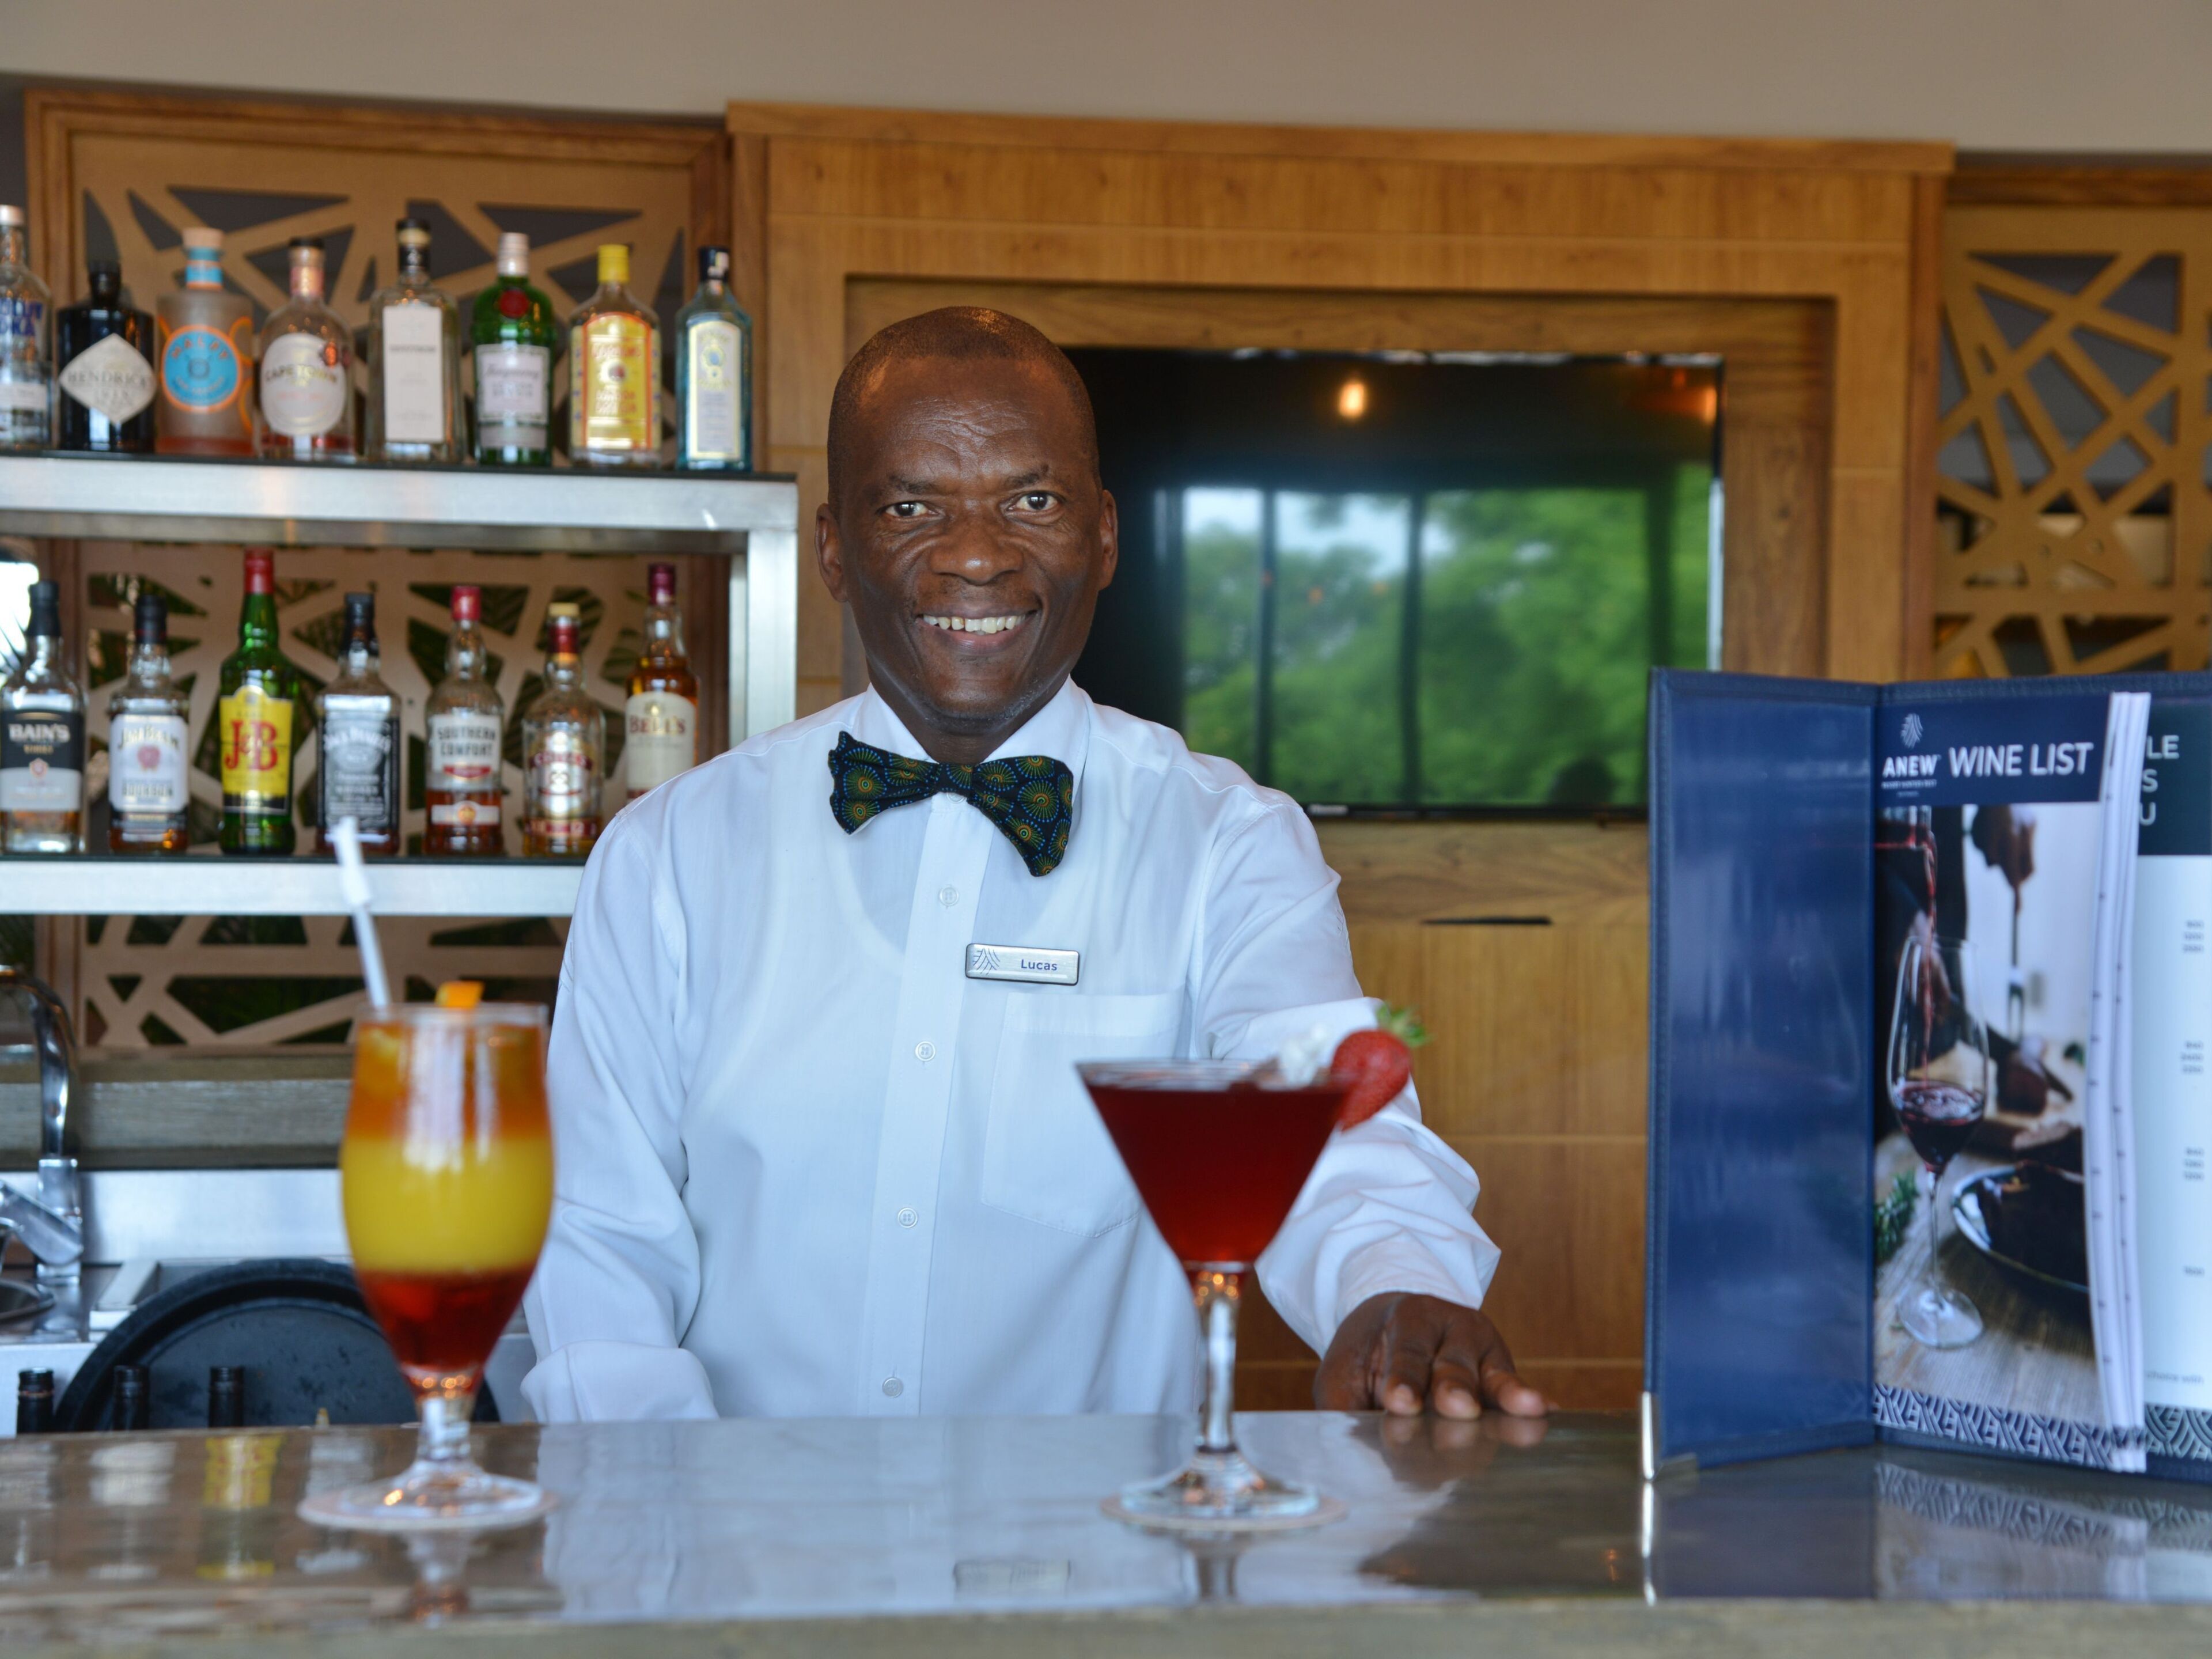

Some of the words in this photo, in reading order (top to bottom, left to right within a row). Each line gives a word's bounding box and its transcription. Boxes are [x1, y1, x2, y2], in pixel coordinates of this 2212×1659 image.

[9, 724, 71, 742] BAIN'S
[437, 726, 496, 741] SOUTHERN
[440, 742, 493, 756] COMFORT
[1882, 755, 1937, 778] ANEW
[1949, 744, 2024, 778] WINE
[2029, 741, 2094, 775] LIST
[1021, 959, 1058, 971] Lucas
